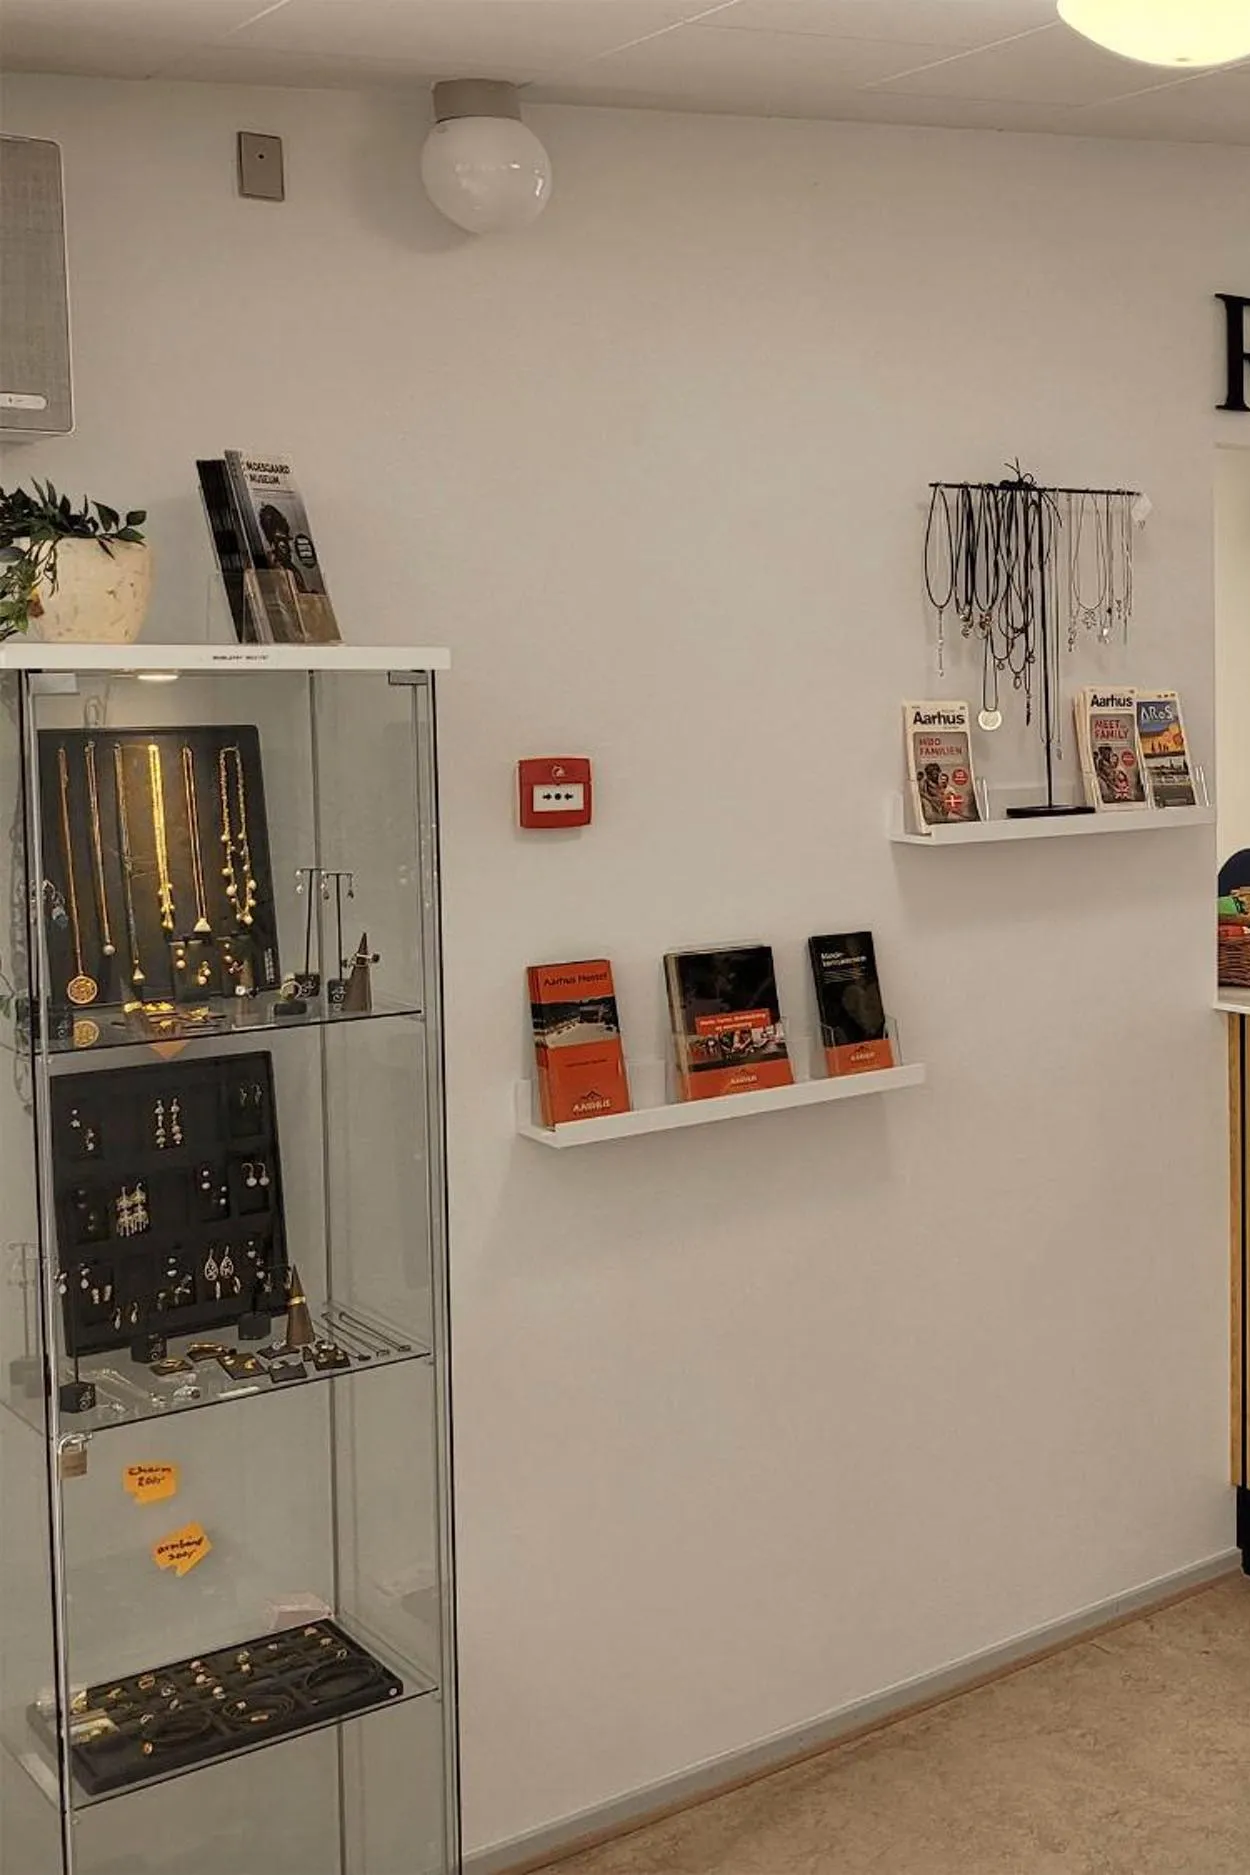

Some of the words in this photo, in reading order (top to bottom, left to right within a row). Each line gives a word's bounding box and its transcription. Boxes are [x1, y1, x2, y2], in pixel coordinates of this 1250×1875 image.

[249, 474, 281, 485] MUSEUM
[1091, 694, 1133, 707] Aarhus
[913, 711, 966, 725] Aarhus
[1095, 720, 1121, 730] MEET
[1095, 728, 1129, 740] FAMILY
[919, 746, 963, 756] FAMILIEN
[544, 976, 577, 987] Aarhus
